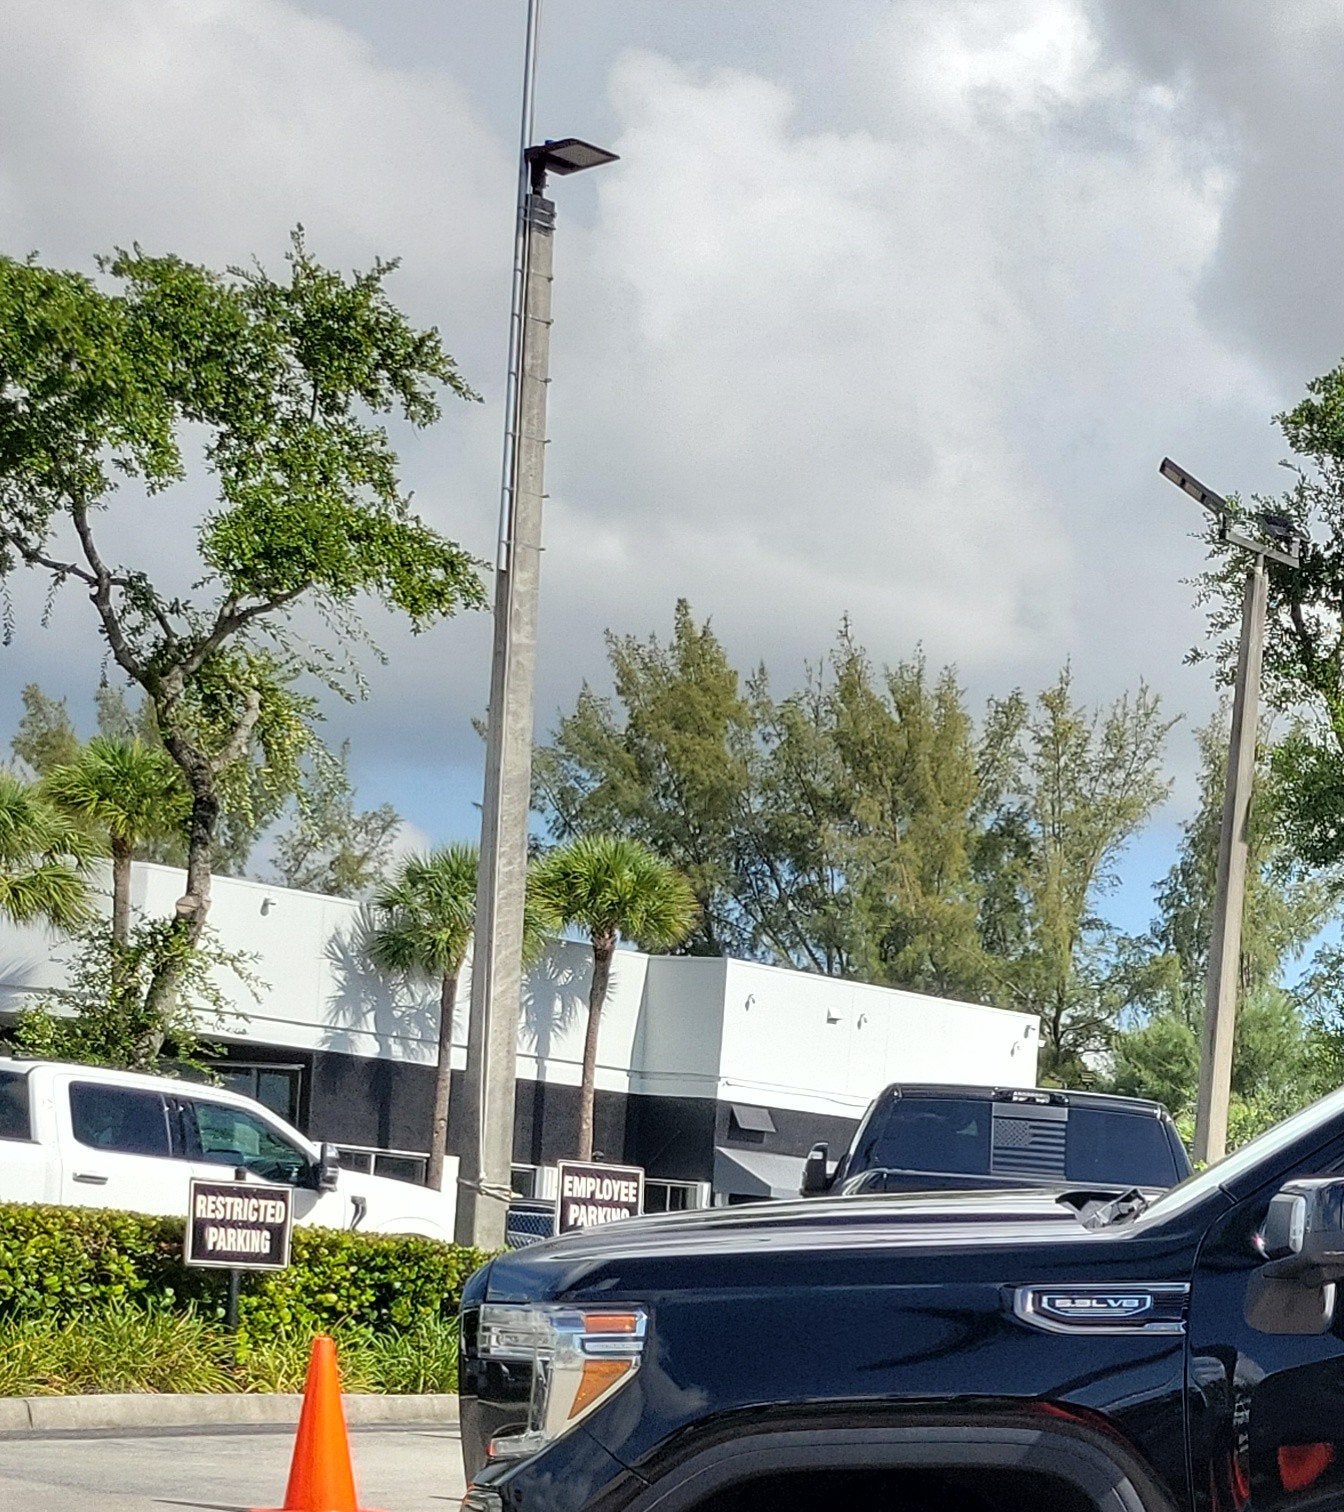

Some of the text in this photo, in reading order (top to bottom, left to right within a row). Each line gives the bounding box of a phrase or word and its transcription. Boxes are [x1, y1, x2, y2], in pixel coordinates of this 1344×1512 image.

[563, 1175, 638, 1203] EMPLOYEE
[195, 1194, 286, 1224] RESTRICTED
[208, 1226, 271, 1254] PARKING
